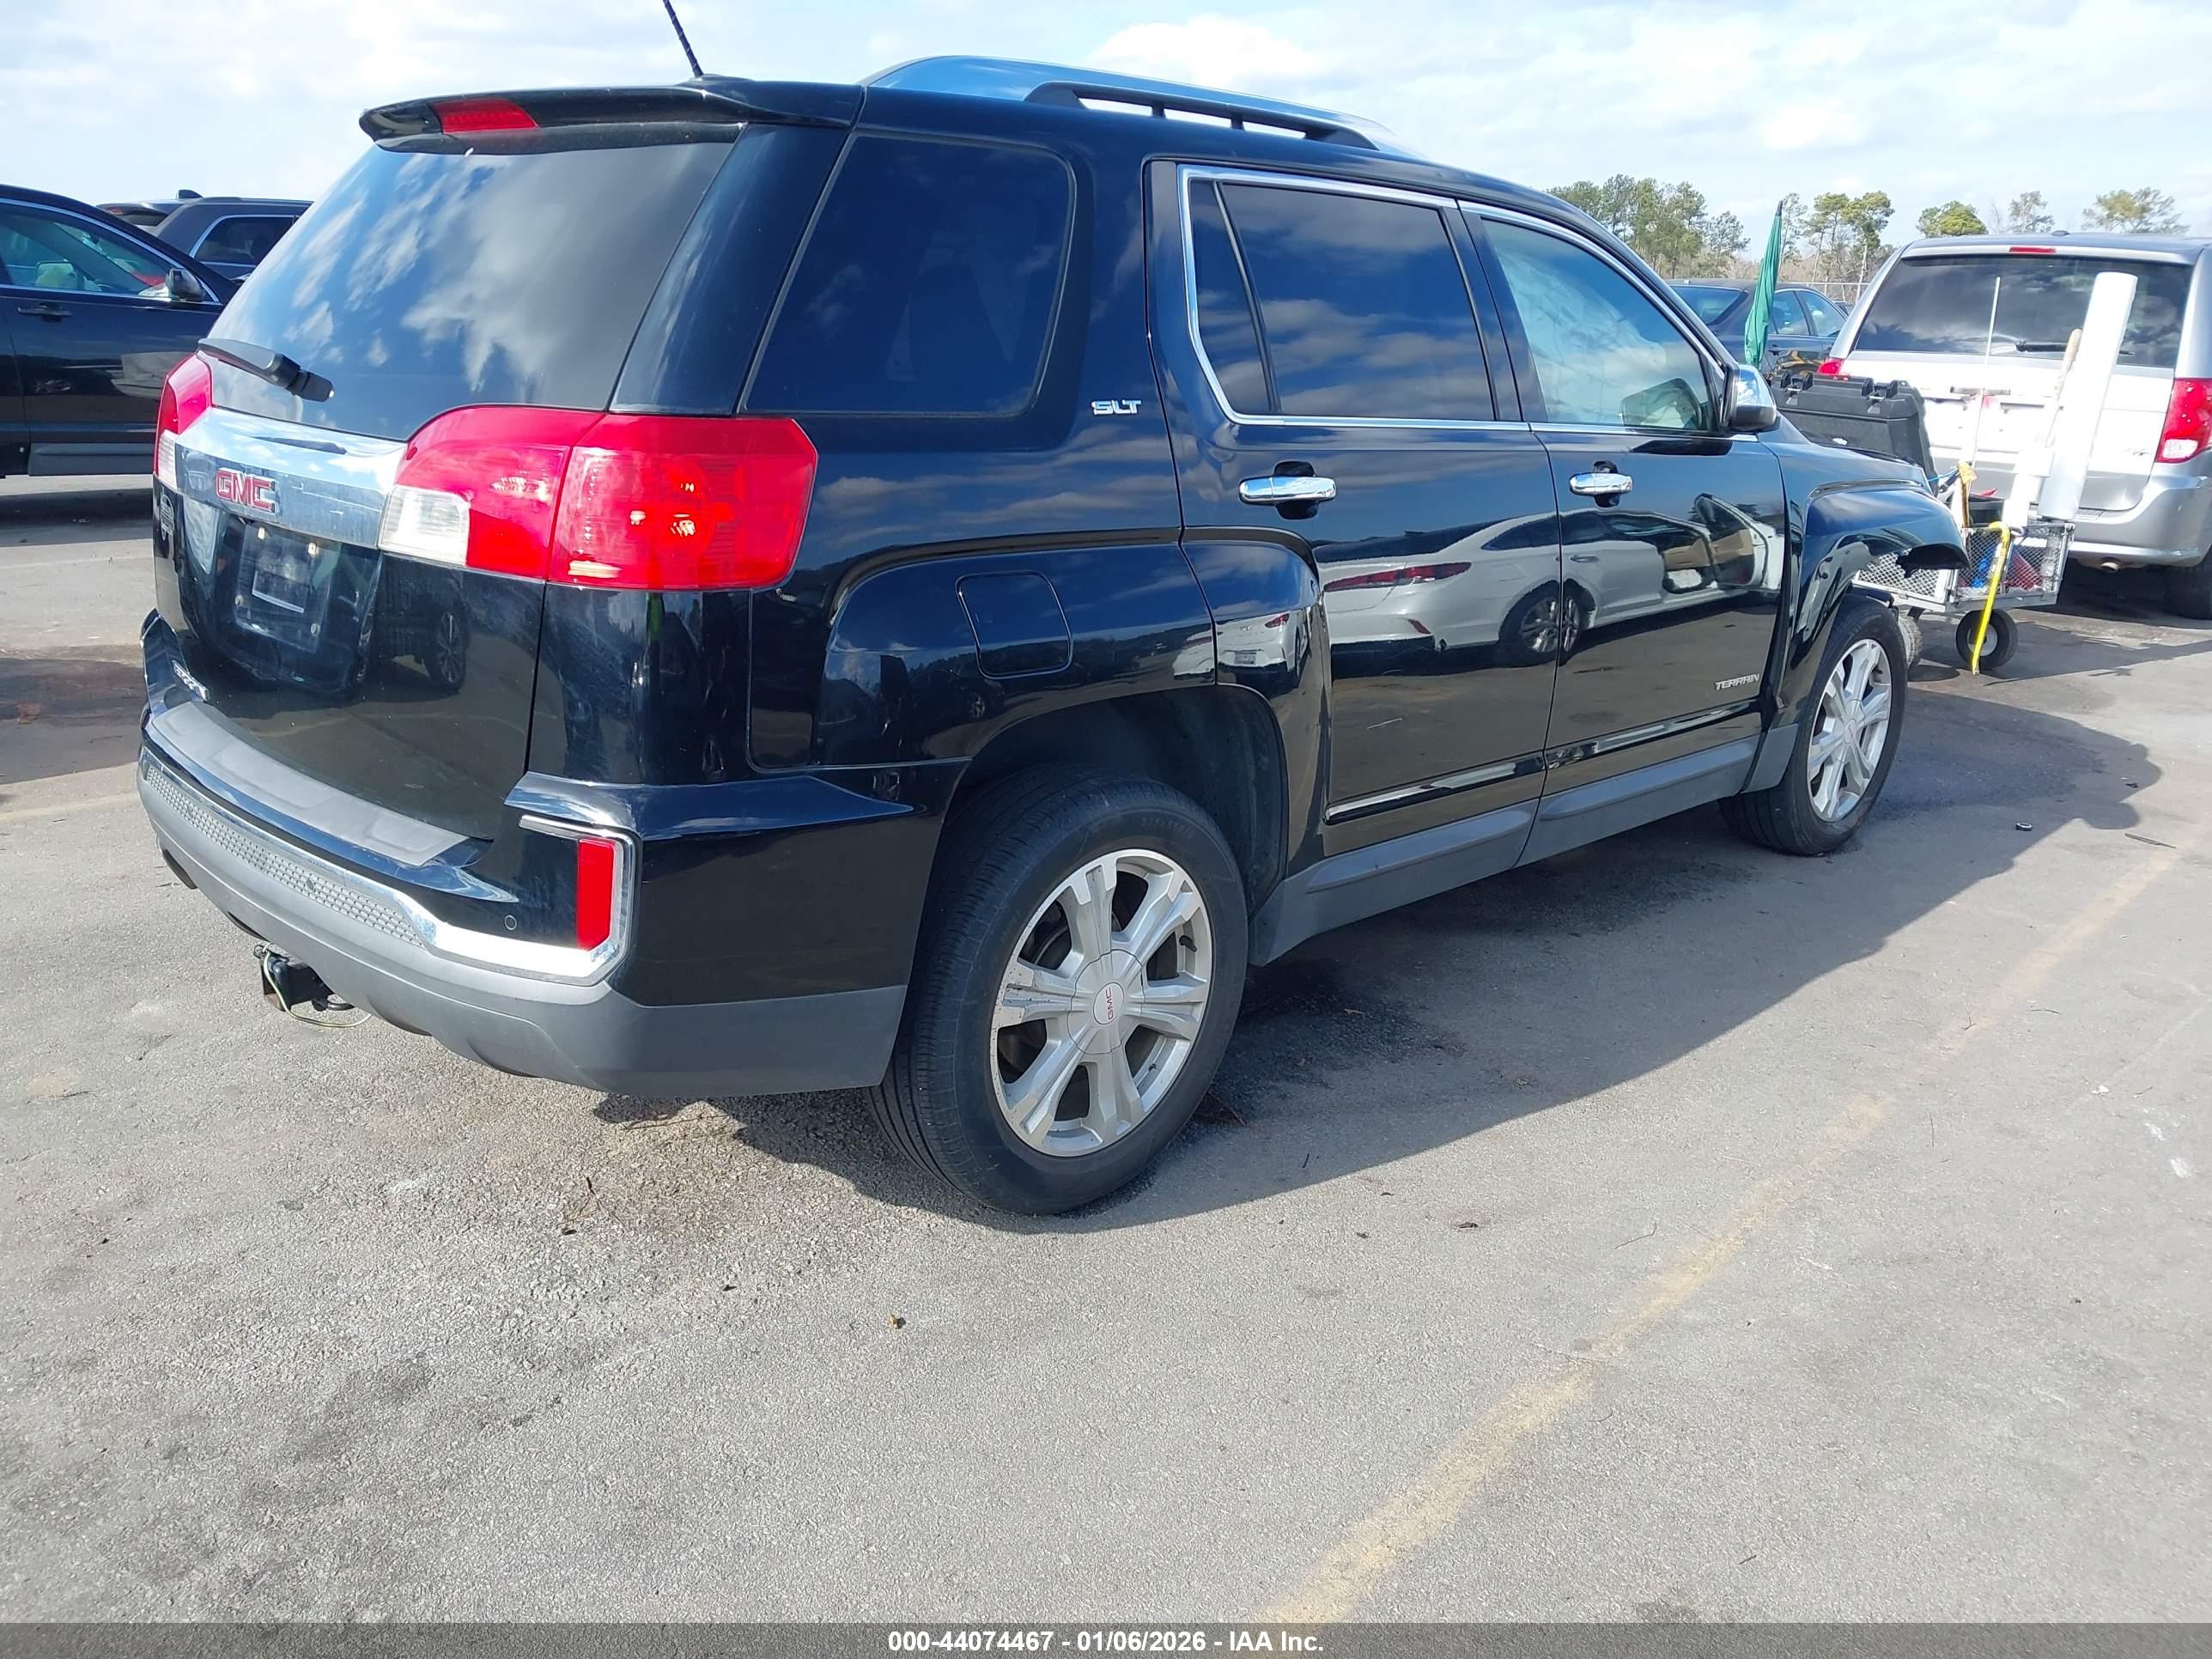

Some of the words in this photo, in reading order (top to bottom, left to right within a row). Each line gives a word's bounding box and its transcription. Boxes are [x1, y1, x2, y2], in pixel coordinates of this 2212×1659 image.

[1091, 399, 1142, 416] SLT
[216, 467, 276, 514] GMC
[1715, 673, 1759, 690] TERRAIN
[1105, 987, 1114, 1020] GMC
